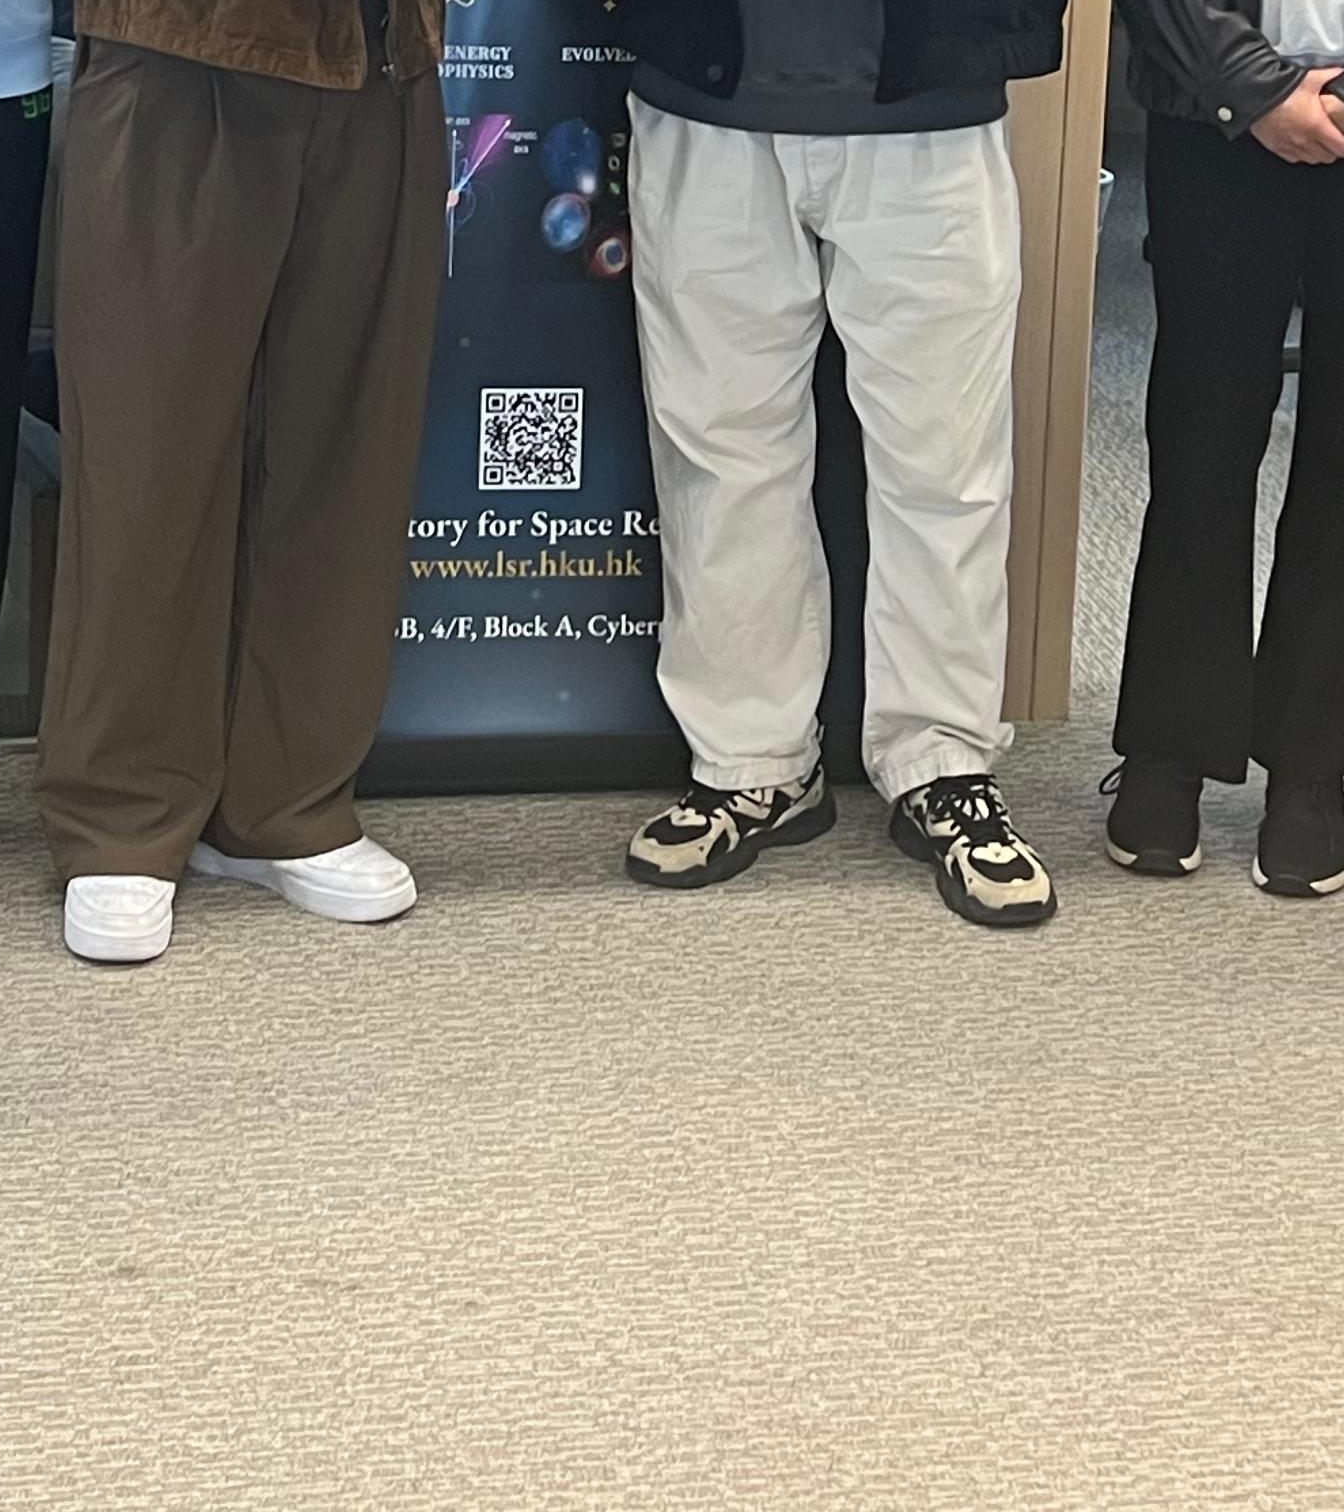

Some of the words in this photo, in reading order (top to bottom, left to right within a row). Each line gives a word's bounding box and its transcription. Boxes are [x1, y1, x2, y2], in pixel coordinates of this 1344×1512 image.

[444, 45, 512, 62] ENERGY
[477, 509, 524, 538] for
[529, 510, 613, 545] Space
[409, 549, 643, 579] www.lsr.hku.hk
[430, 615, 478, 643] 4/F,
[483, 614, 549, 639] Block
[554, 615, 582, 641] A,
